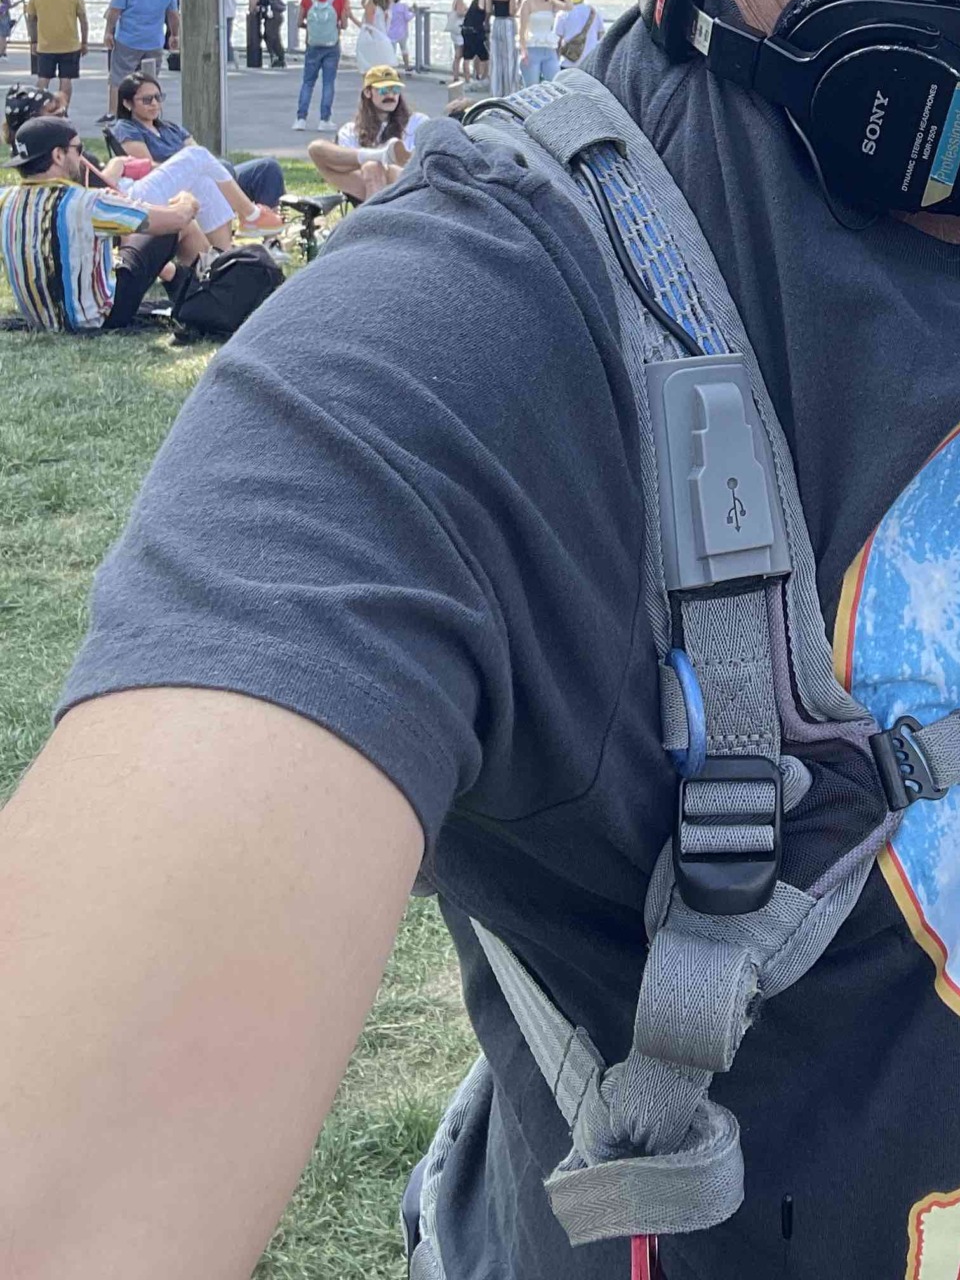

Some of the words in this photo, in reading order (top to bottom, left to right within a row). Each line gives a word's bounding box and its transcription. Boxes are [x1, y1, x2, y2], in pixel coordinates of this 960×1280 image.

[862, 90, 889, 155] SONY
[901, 160, 916, 192] DYNAMIC
[911, 132, 924, 159] STEREO
[919, 84, 938, 131] HEADPHONES
